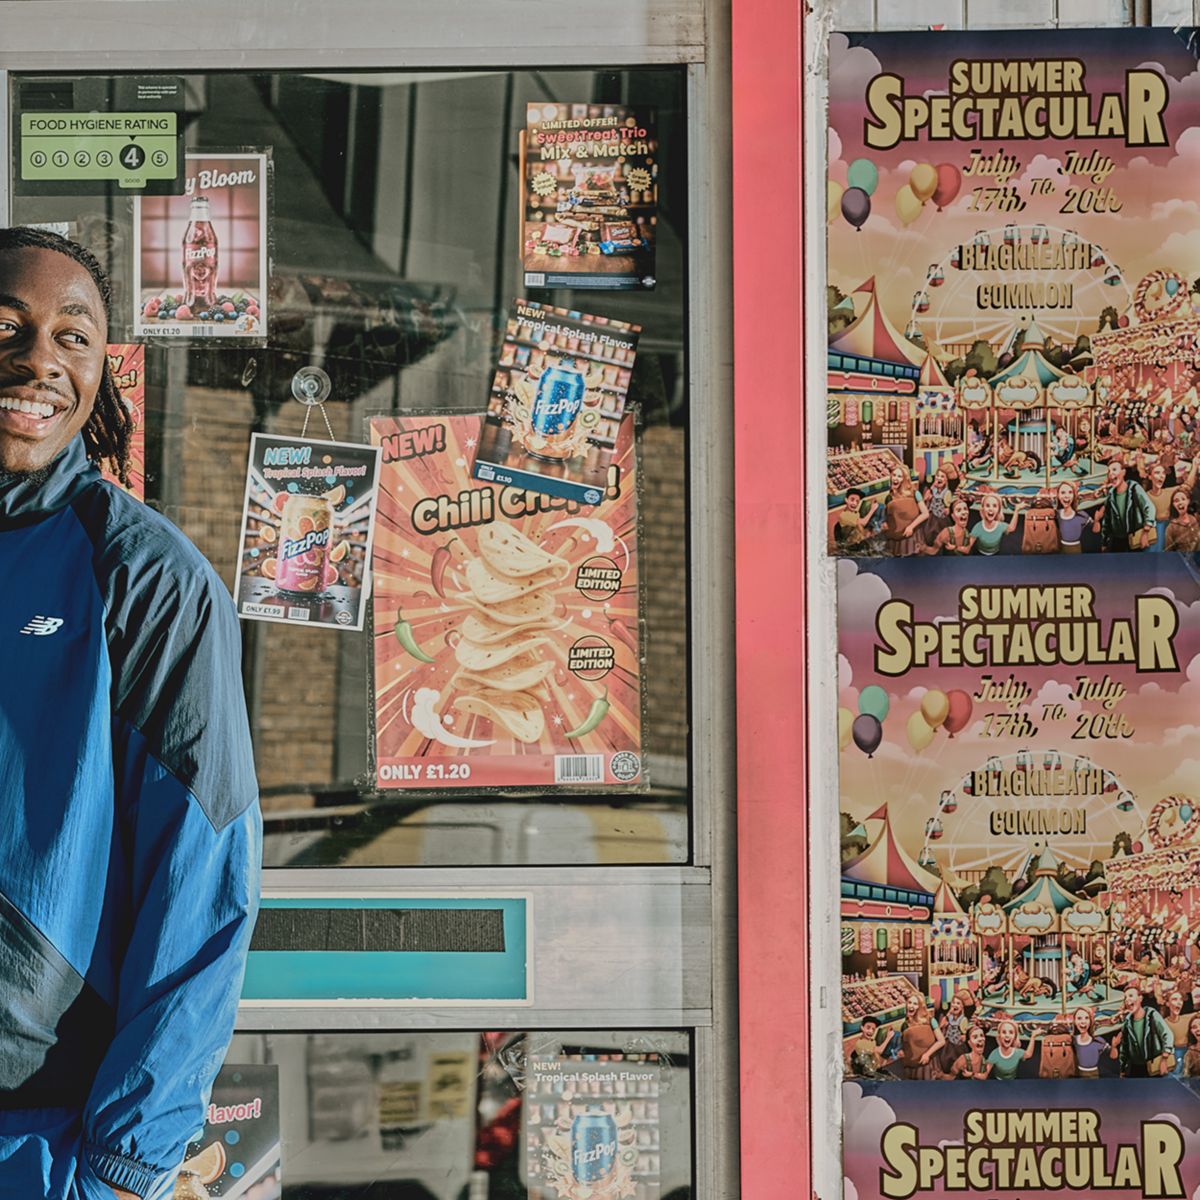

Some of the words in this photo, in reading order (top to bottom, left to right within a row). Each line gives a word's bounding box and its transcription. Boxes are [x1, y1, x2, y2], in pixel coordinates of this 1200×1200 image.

[952, 61, 1083, 93] SUMMER
[866, 71, 1168, 147] SPECTACULAR
[30, 119, 67, 130] FOOD
[70, 119, 122, 130] HYGIENE
[124, 119, 168, 130] RATING
[542, 119, 580, 130] LIMITED
[583, 117, 618, 127] OFFER!
[537, 129, 617, 144] SweetTreat
[620, 127, 647, 138] Trio
[540, 146, 571, 160] Mix
[576, 145, 588, 159] &
[593, 142, 648, 158] Match
[963, 149, 1020, 183] July
[1057, 150, 1115, 184] July
[198, 169, 256, 190] Bloom
[517, 305, 546, 320] NEW!
[143, 327, 162, 336] ONLY
[162, 327, 181, 336] £1.20
[517, 316, 561, 335] Tropical
[562, 327, 598, 344] Splash
[599, 335, 633, 350] Flavor
[380, 424, 446, 463] NEW!
[263, 446, 312, 466] NEW!
[412, 485, 495, 535] Chili
[577, 567, 621, 582] LIMITED
[576, 578, 621, 592] EDITION
[961, 586, 1094, 620] SUMMER
[875, 597, 1178, 675] SPECTACULAR
[569, 647, 614, 661] LIMITED
[569, 658, 614, 671] EDITION
[974, 674, 1032, 710] July
[1068, 675, 1127, 710] July
[379, 764, 422, 782] ONLY
[425, 763, 471, 780] £1.20
[533, 1061, 561, 1072] NEW!
[535, 1072, 580, 1083] Tropical
[581, 1072, 617, 1083] Splash
[620, 1072, 654, 1082] Flavor
[207, 1098, 262, 1124] lavor!
[967, 1110, 1098, 1144] SUMMER
[882, 1123, 1184, 1198] SPECTACULAR
